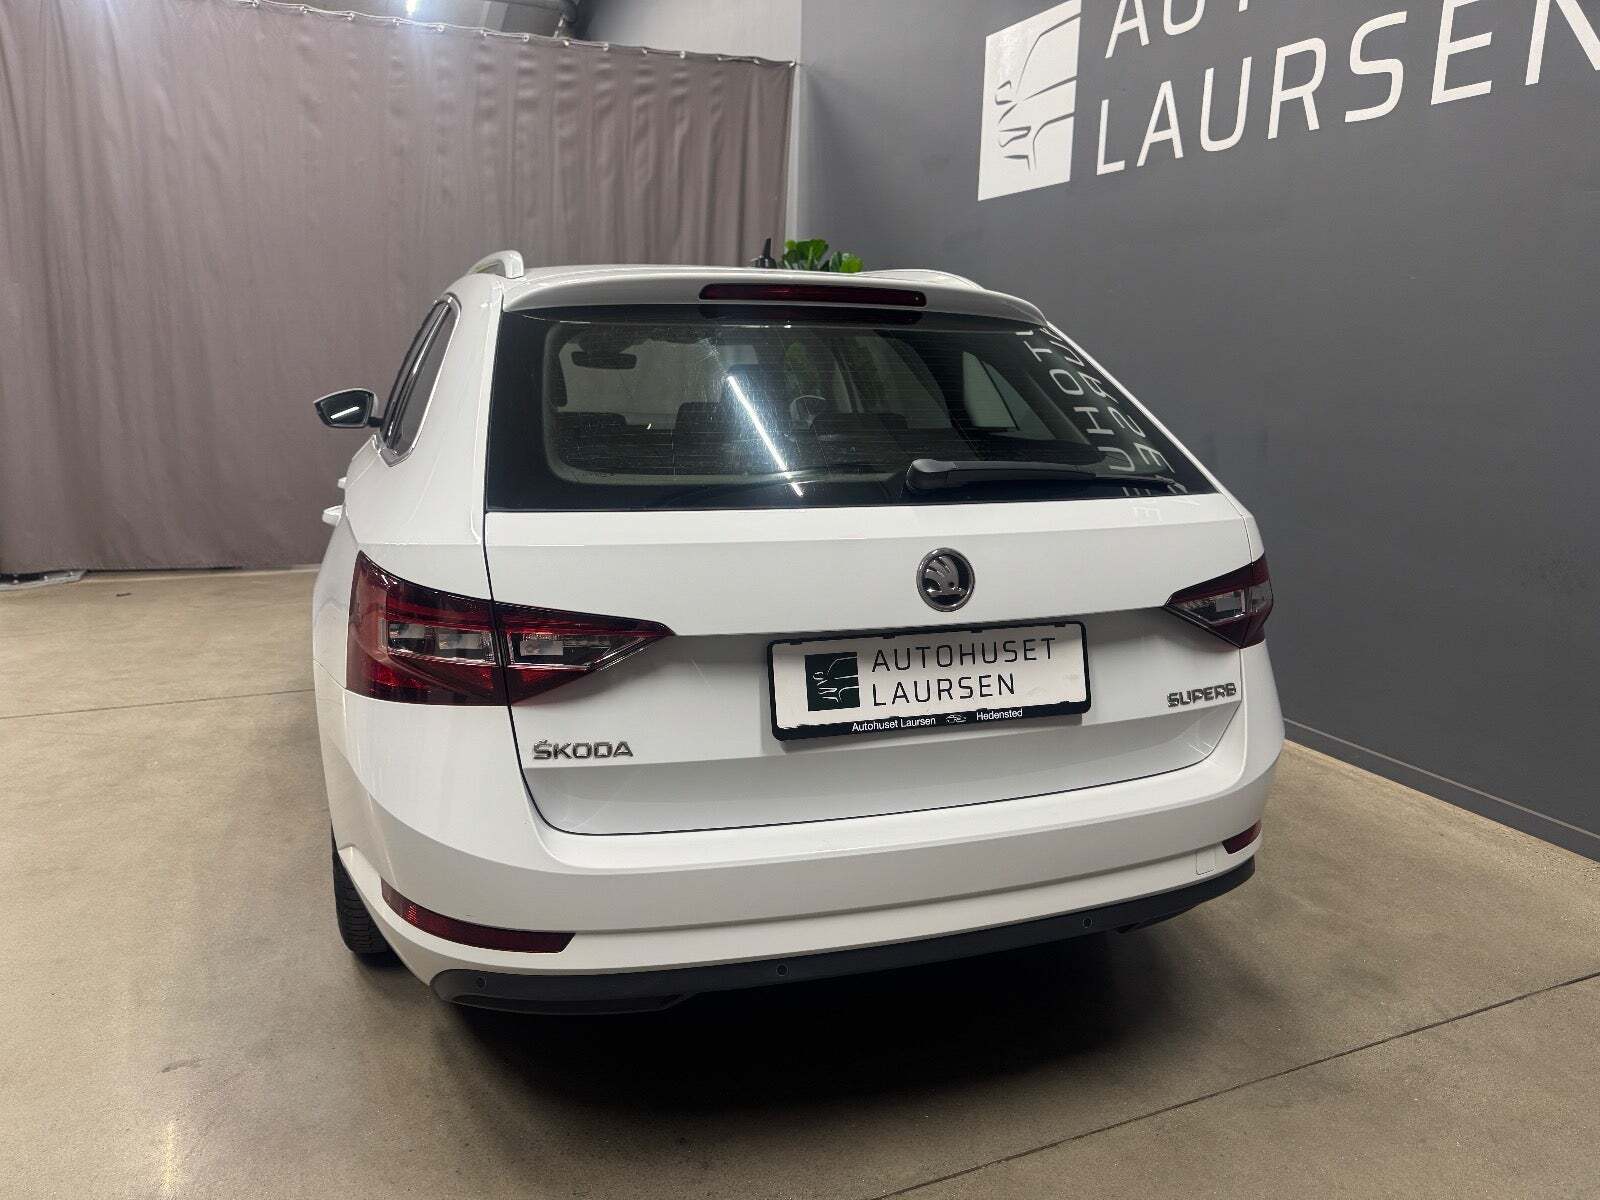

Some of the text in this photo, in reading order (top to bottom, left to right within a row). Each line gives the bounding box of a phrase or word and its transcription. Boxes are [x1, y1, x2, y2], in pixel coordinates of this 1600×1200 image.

[871, 637, 1056, 673] AUTOHUSET
[871, 673, 1016, 707] LAURSEN
[1167, 682, 1237, 707] SUPERB
[851, 708, 1023, 732] Autohuset Laursen Hedensted
[533, 739, 634, 760] ŠKODA
